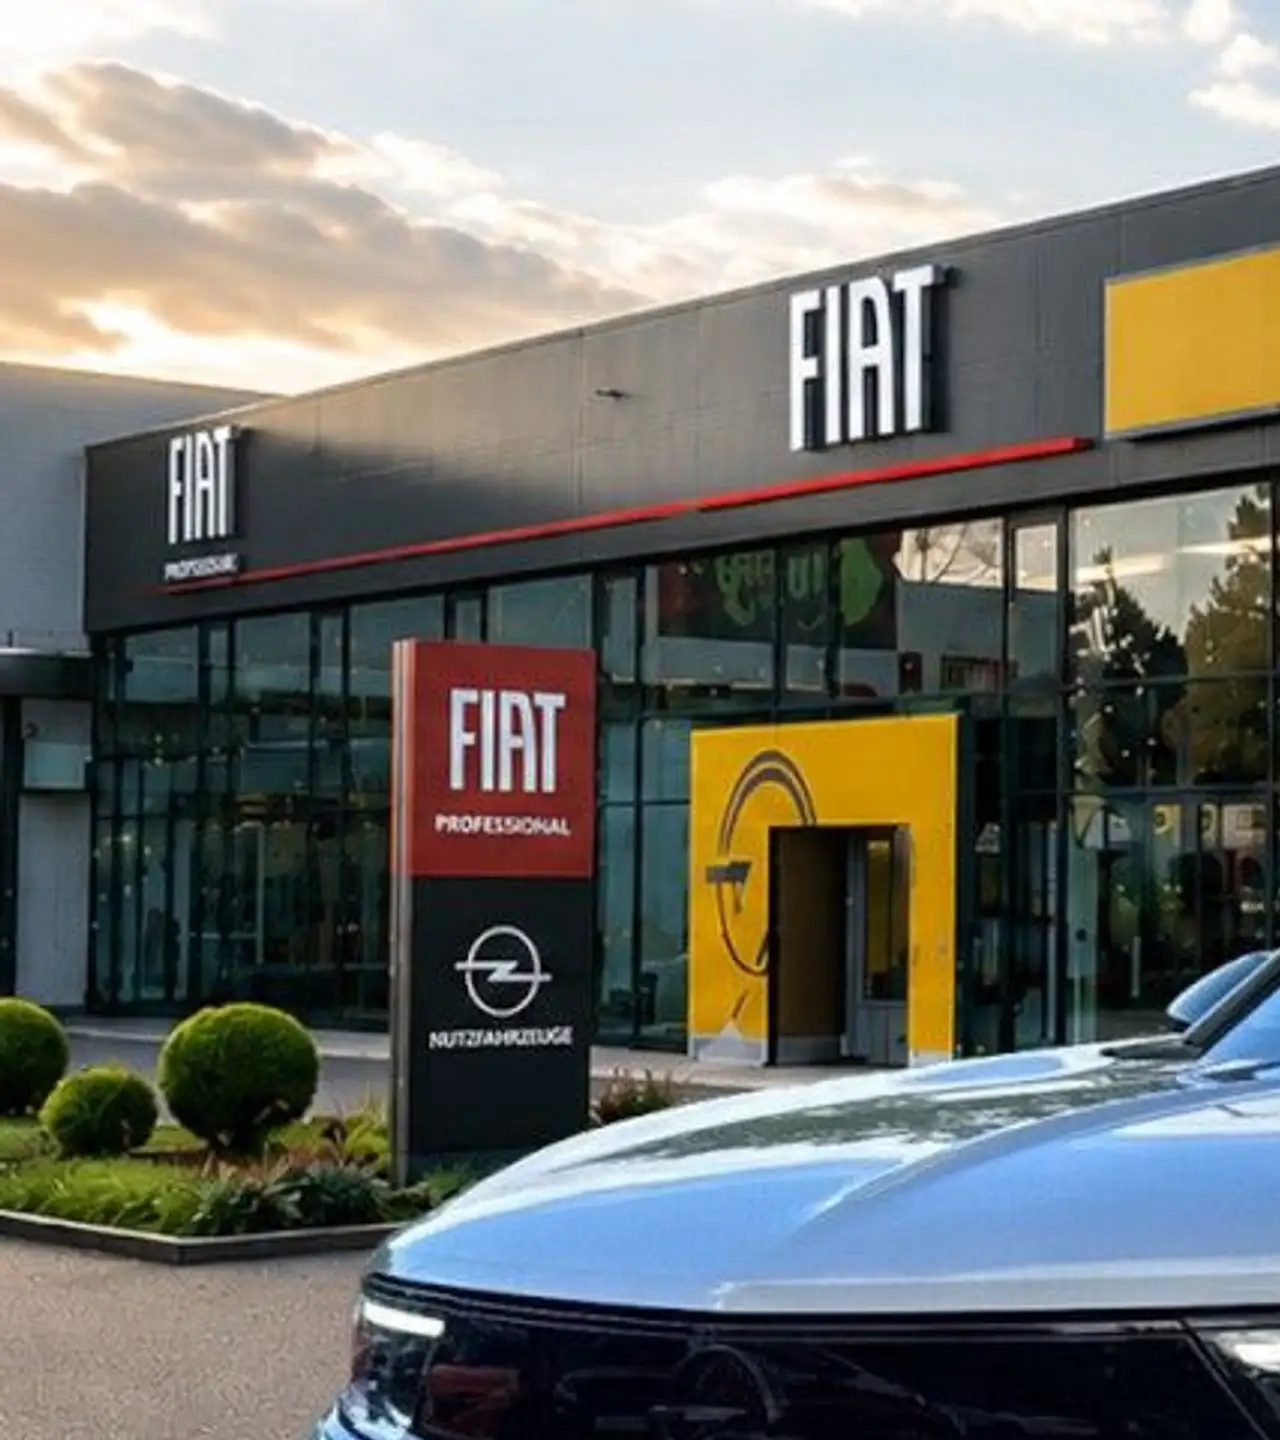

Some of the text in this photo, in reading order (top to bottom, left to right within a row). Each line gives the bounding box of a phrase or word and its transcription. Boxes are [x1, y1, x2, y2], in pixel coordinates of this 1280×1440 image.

[789, 263, 936, 452] FIAT
[167, 424, 234, 546] FIAT
[450, 687, 567, 793] FIAT
[434, 813, 571, 836] PROFESSIONAL
